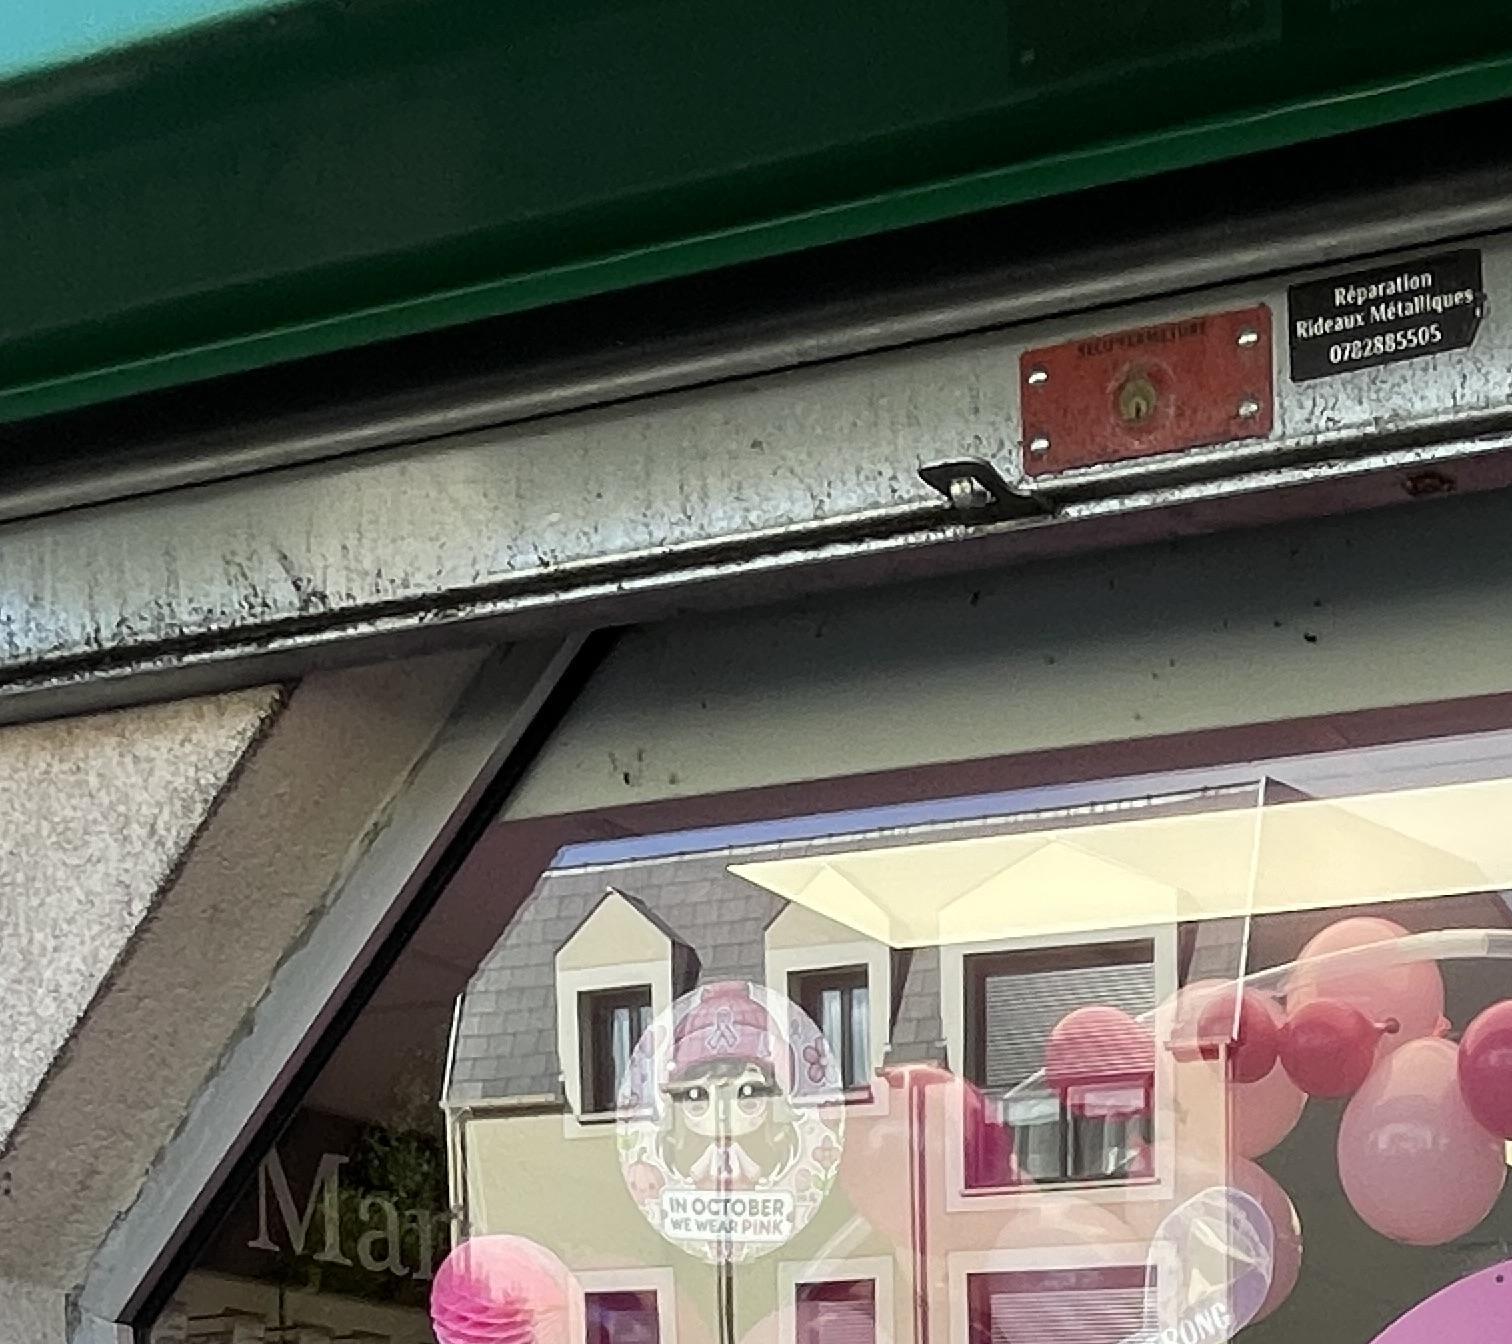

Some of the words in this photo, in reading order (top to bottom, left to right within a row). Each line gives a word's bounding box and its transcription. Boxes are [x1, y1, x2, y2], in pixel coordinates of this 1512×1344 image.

[1334, 272, 1432, 307] Réparation
[1296, 310, 1366, 339] Rideaux
[1369, 288, 1475, 314] Métalliques
[1329, 324, 1442, 364] 0782885505
[669, 1197, 688, 1214] IN
[692, 1198, 784, 1217] OCTOBER
[670, 1217, 692, 1232] WE
[696, 1218, 738, 1234] WEAR
[742, 1218, 783, 1236] PINK
